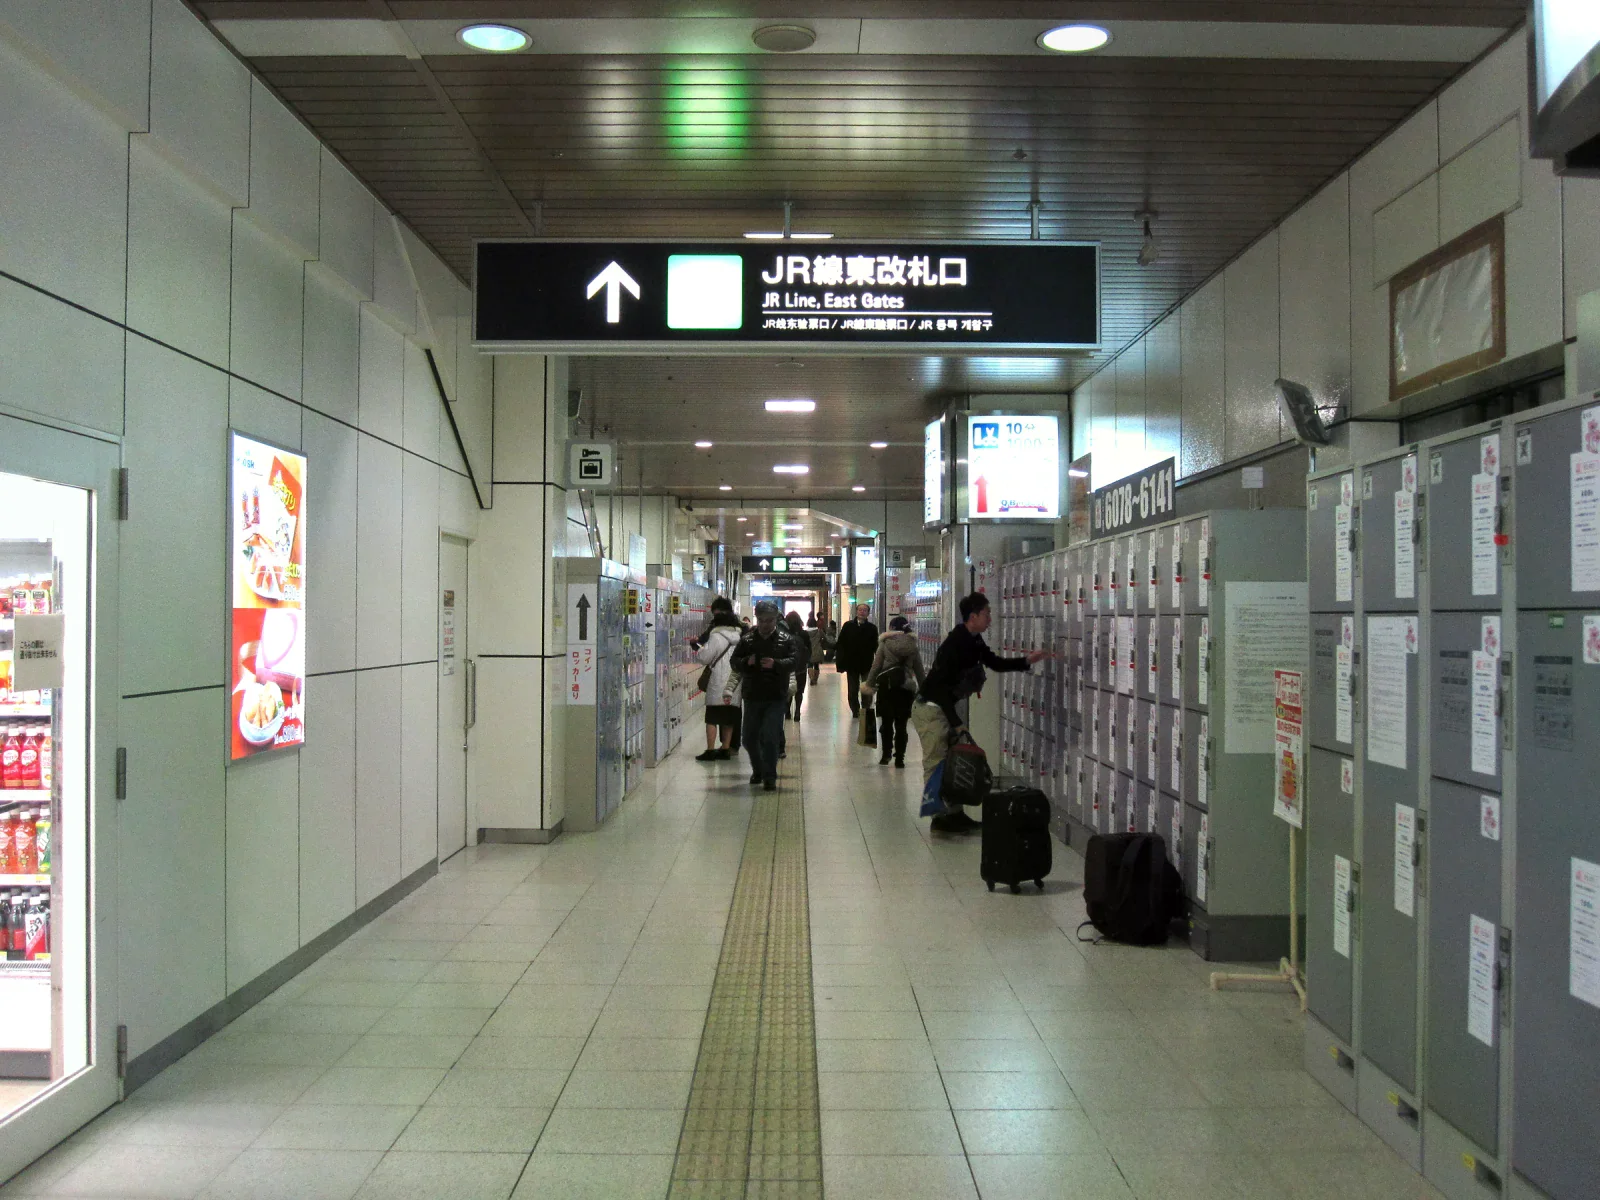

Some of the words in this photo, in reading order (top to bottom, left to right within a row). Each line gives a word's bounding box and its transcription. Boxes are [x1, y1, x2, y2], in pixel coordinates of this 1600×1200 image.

[762, 255, 968, 286] JR線東改札口
[762, 293, 780, 308] JR
[785, 293, 821, 309] Line,
[824, 293, 857, 308] East
[861, 293, 905, 308] Gates
[584, 648, 592, 673] コイン
[572, 652, 580, 700] ロッカー通り
